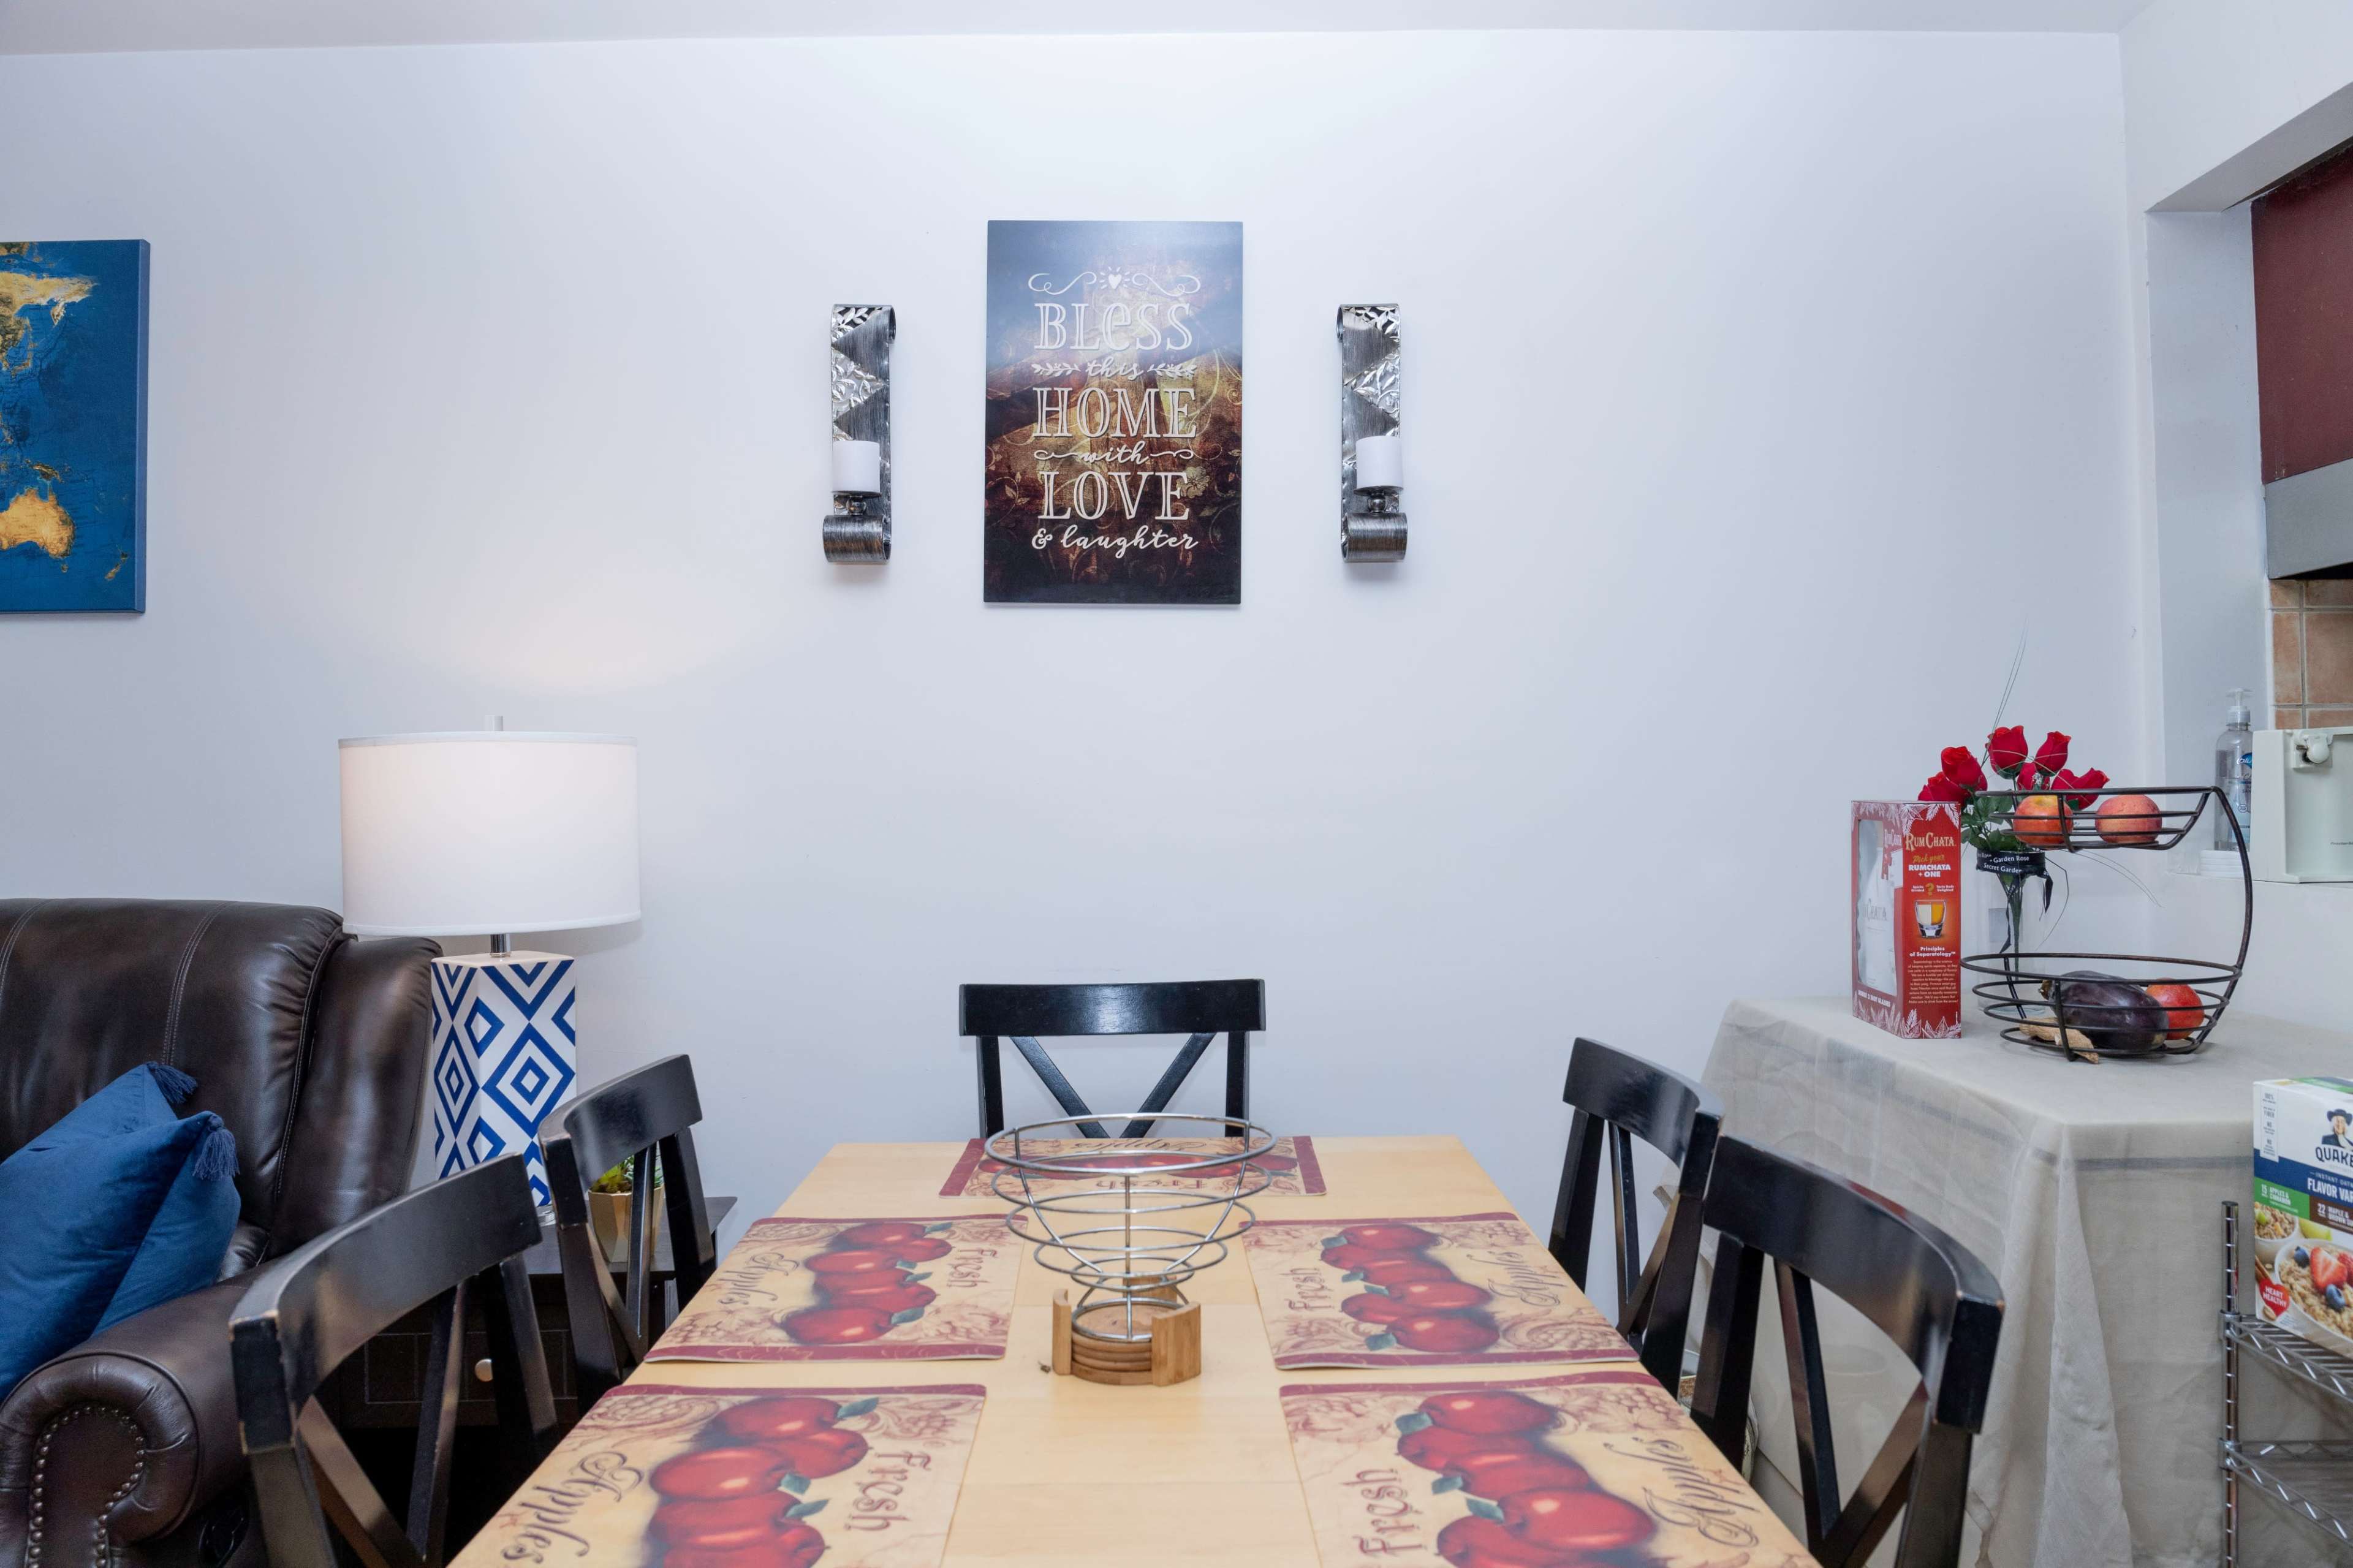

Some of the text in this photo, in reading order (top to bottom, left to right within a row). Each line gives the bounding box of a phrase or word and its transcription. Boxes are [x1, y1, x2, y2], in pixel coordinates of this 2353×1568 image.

[1085, 356, 1144, 379] this
[1033, 387, 1197, 438] HOME
[1082, 440, 1150, 465] with
[1038, 471, 1189, 521] LOVE
[1031, 525, 1199, 559] & laughter
[2307, 1177, 2338, 1199] FLAVOR
[2316, 1173, 2338, 1184] INSTANT
[2317, 1203, 2326, 1214] 22
[947, 1248, 999, 1288] Fresh
[1280, 1268, 1335, 1311] Fresh
[2263, 1292, 2287, 1308] HEALTHY
[2265, 1286, 2283, 1299] HEART
[501, 1451, 643, 1564] Apples
[844, 1450, 932, 1531] Fresh
[1603, 1437, 1760, 1547] Apples
[1341, 1468, 1425, 1557] Fresh
